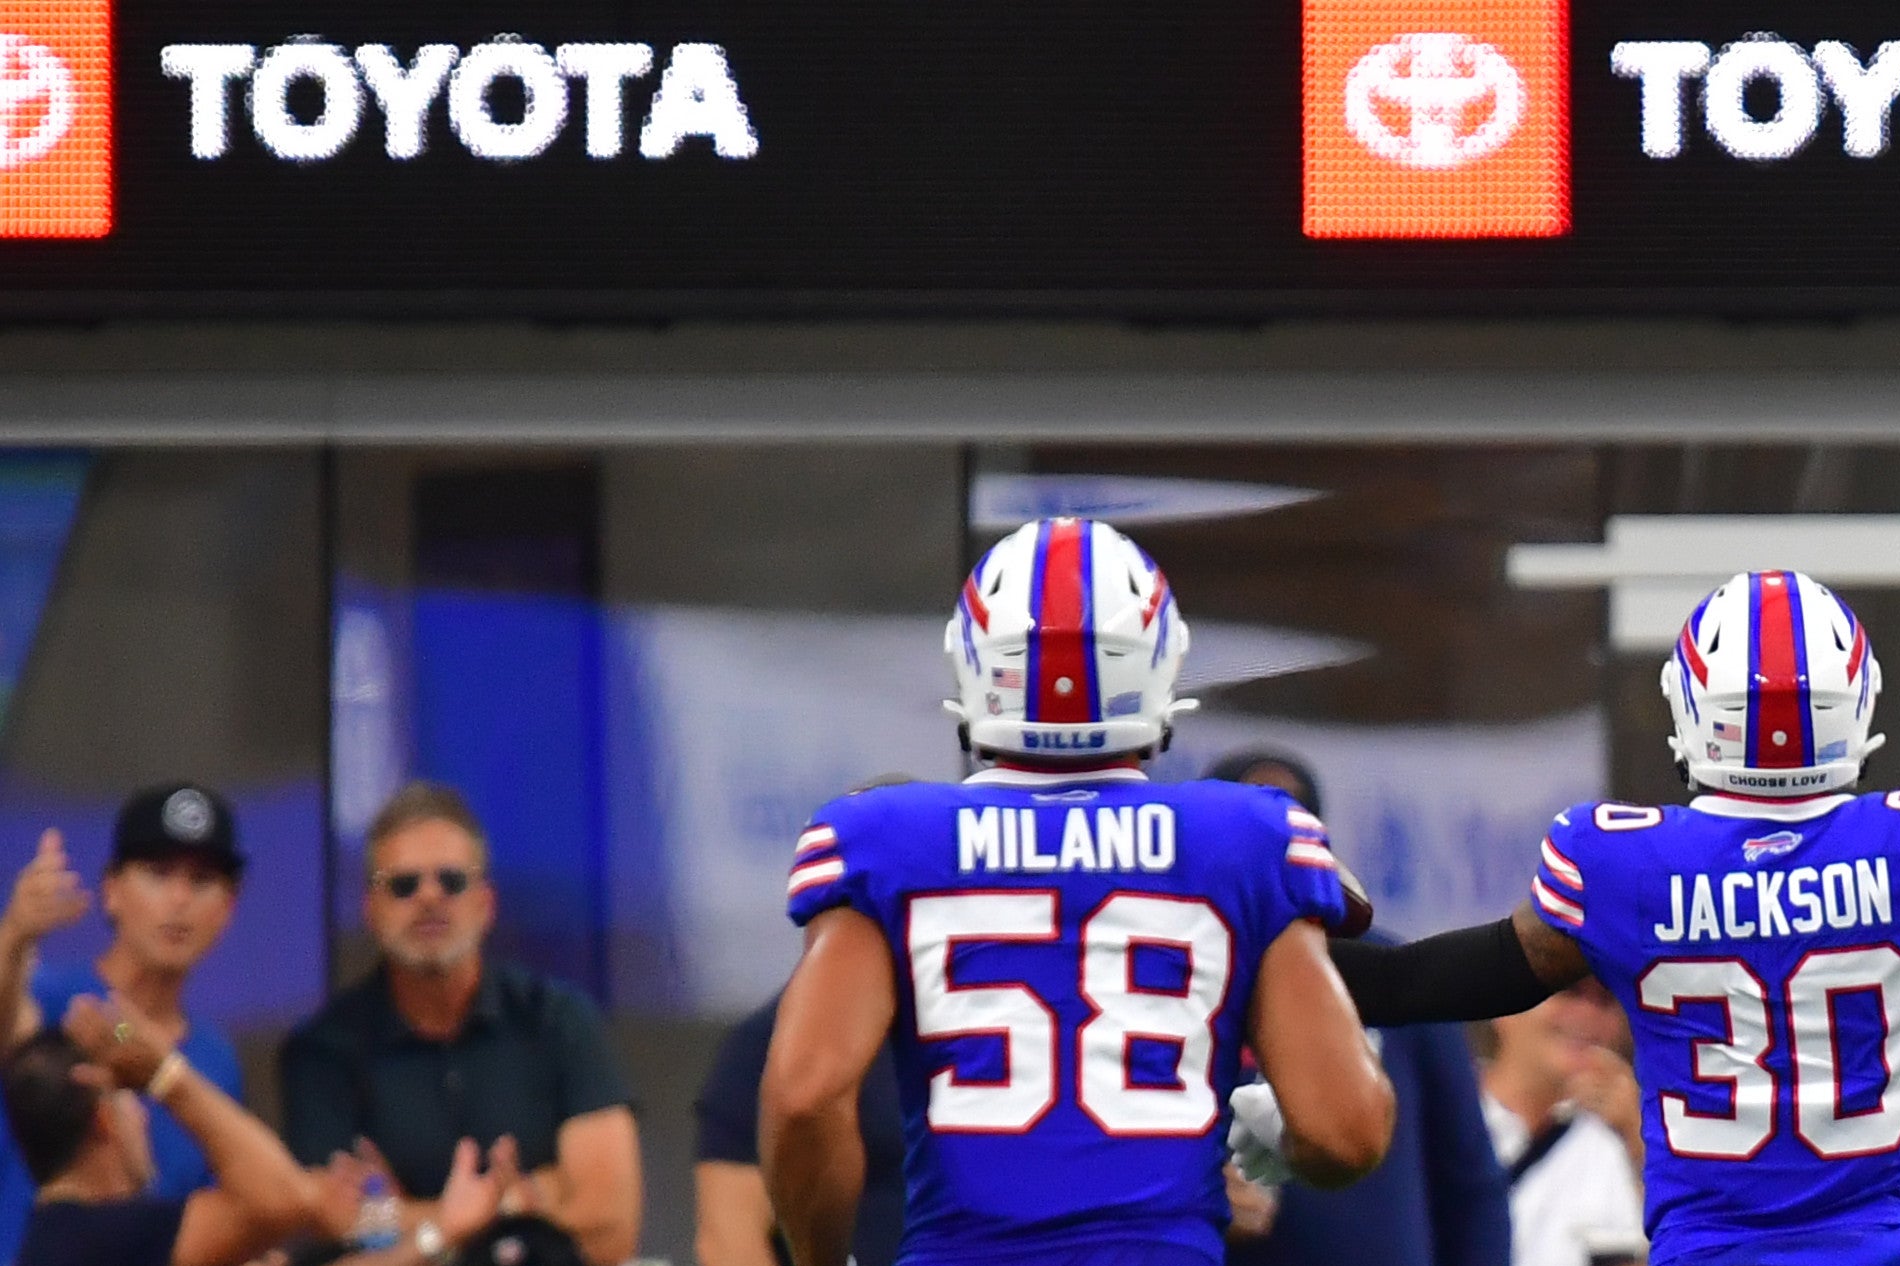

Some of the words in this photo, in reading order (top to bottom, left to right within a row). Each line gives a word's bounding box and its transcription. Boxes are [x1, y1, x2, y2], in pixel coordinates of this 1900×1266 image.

[160, 33, 760, 162] TOYOTA
[1021, 730, 1108, 749] BILLS
[1728, 773, 1788, 788] CHOOSE
[1791, 772, 1828, 787] LOVE
[957, 802, 1177, 874] MILANO
[1653, 856, 1893, 943] JACKSON
[905, 888, 1234, 1138] 58
